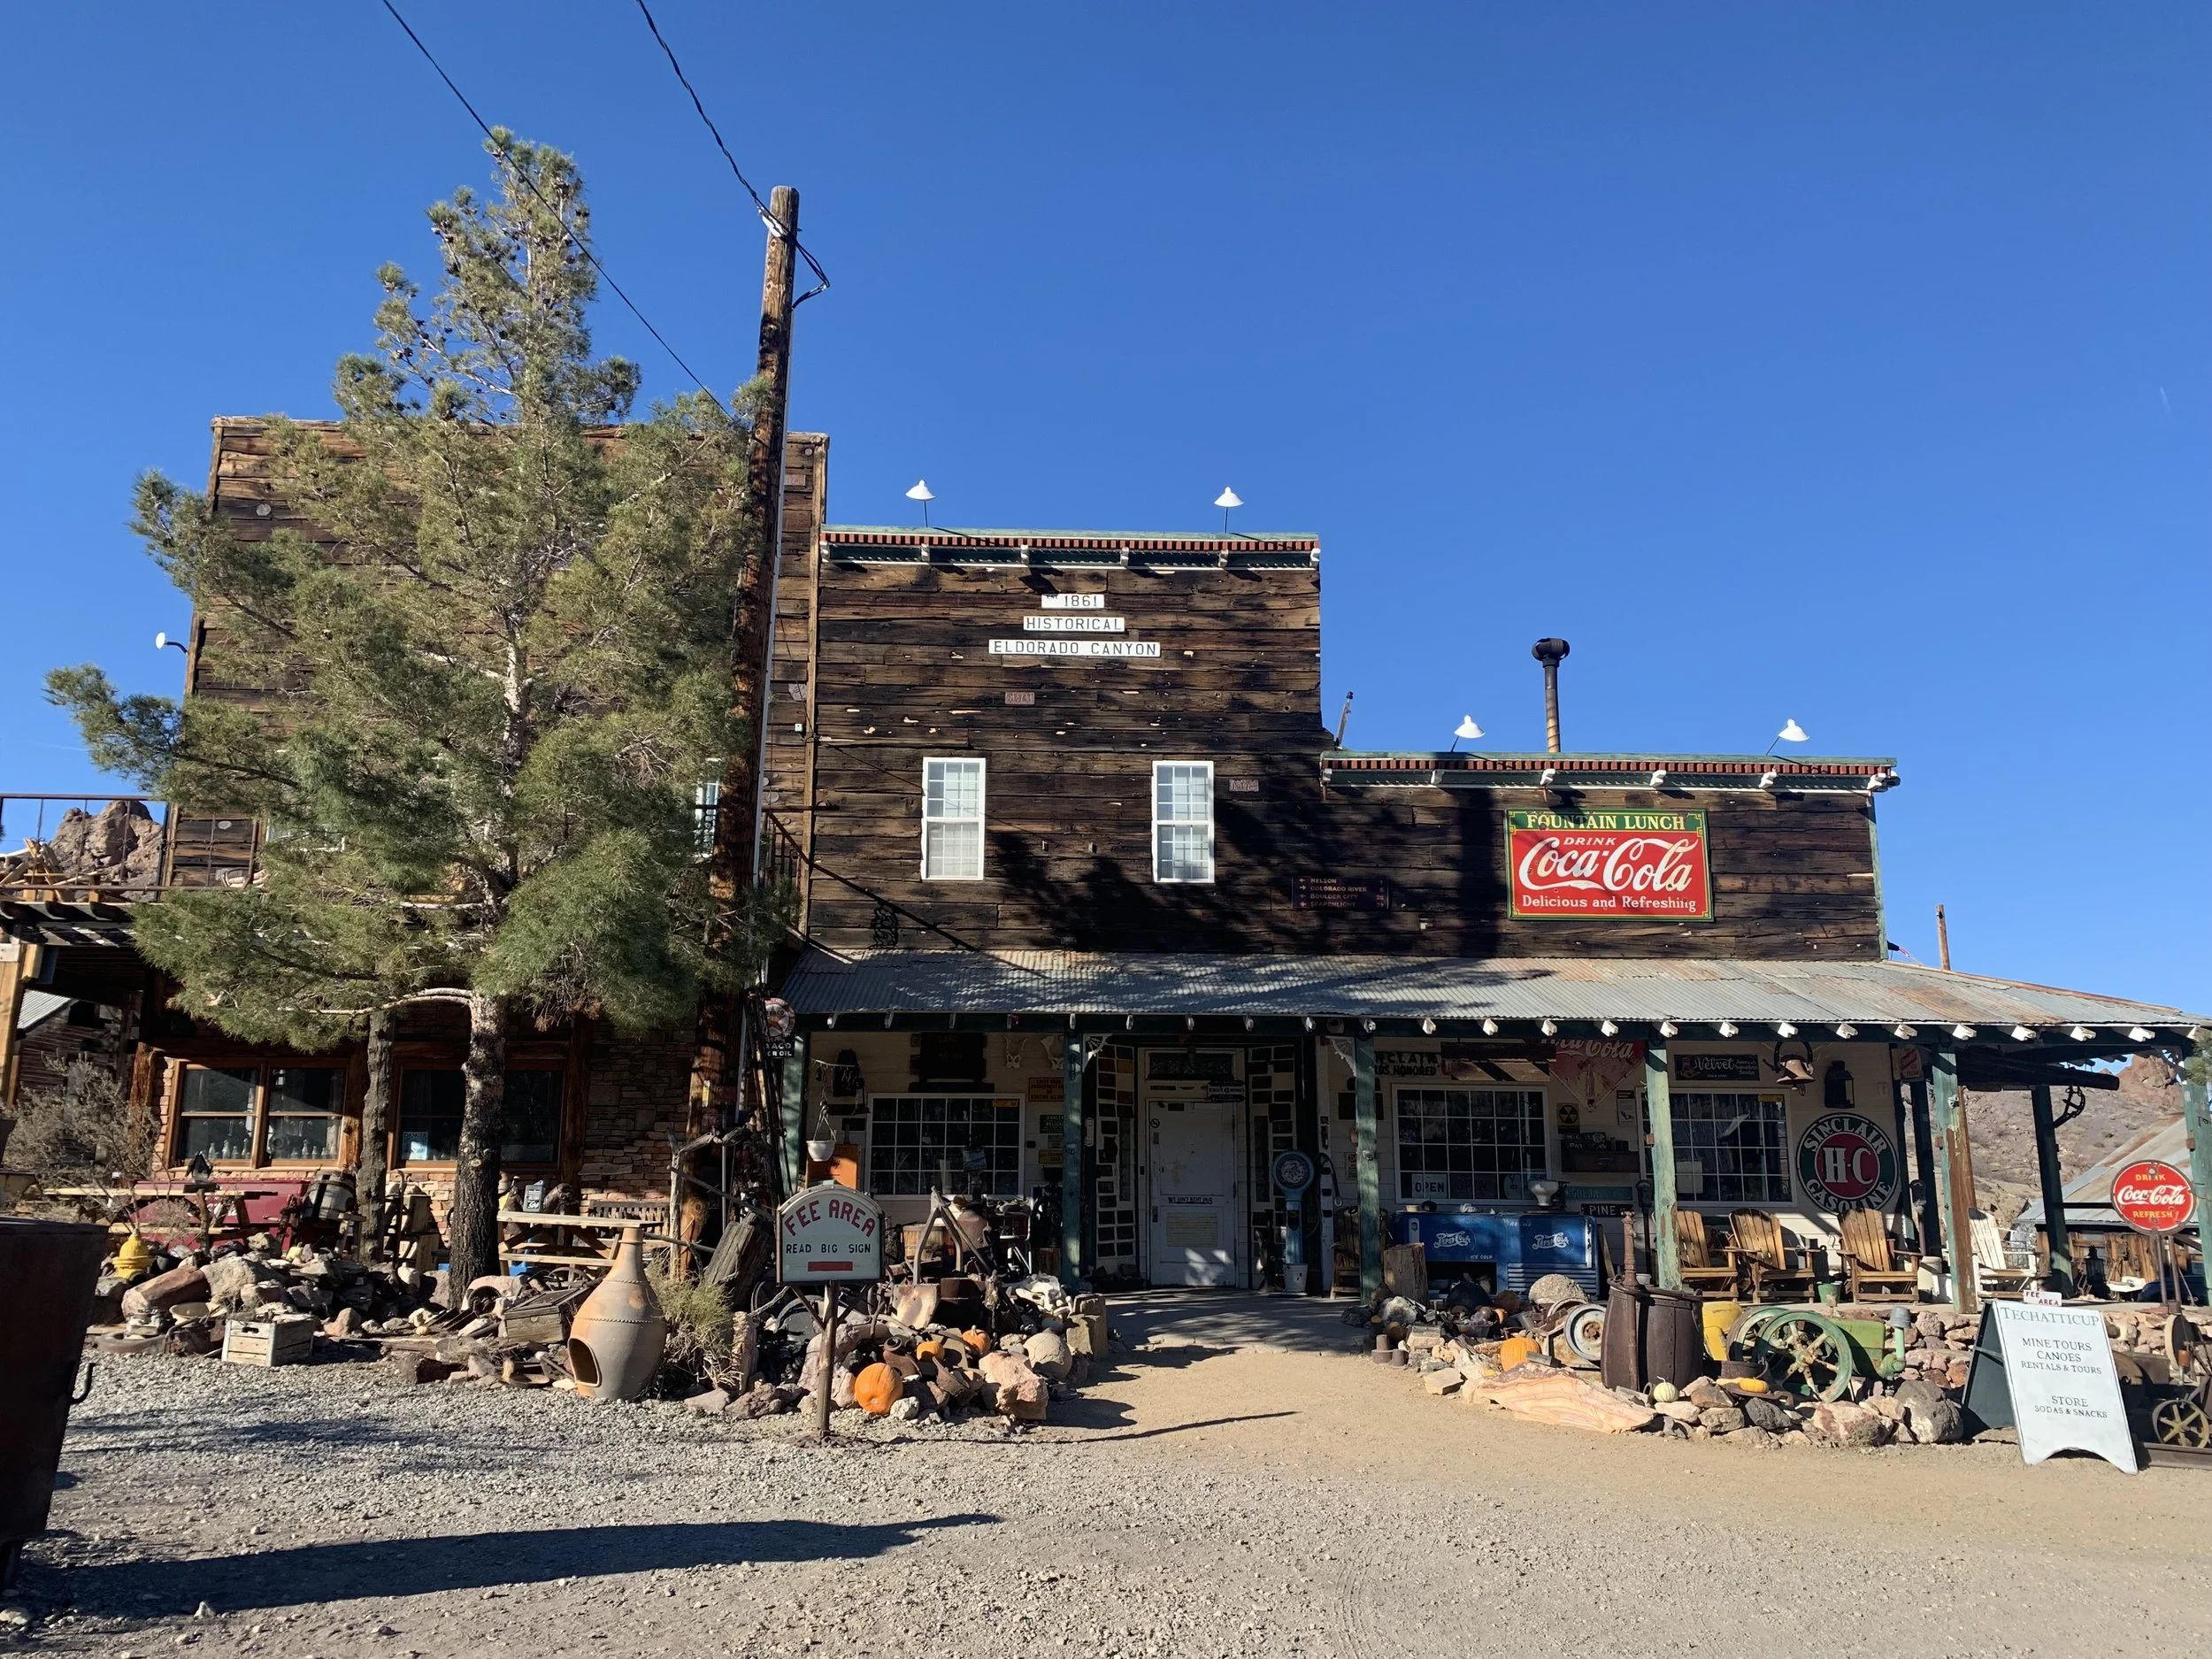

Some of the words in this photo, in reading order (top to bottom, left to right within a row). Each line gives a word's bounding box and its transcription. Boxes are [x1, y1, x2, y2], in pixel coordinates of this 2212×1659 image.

[1064, 595, 1098, 607] 1861
[1025, 618, 1122, 631] HISTORICAL
[994, 641, 1079, 655] ELDORADO
[1091, 642, 1156, 656] CANYON
[1526, 815, 1621, 830] FOUNTAIN
[1624, 816, 1686, 830] LUNCH
[1563, 837, 1617, 846] DRINK
[1518, 836, 1699, 892] Coca-Cola
[1522, 895, 1588, 908] Delicious
[1593, 896, 1616, 908] and
[1622, 895, 1696, 912] Refreshing
[1393, 1064, 1437, 1076] HONORED
[1692, 1056, 1736, 1071] Velvet
[1804, 1118, 1887, 1154] SINCLAIR
[1415, 1181, 1445, 1193] OPEN
[1589, 1205, 1617, 1216] PINE
[784, 1200, 821, 1237] FEE
[828, 1199, 876, 1238] AREA
[786, 1244, 812, 1254] READ
[821, 1243, 838, 1254] BIG
[849, 1243, 872, 1254] SIGN
[2000, 1307, 2100, 1326] TECHATTICUP
[2022, 1337, 2052, 1348] MINE
[2053, 1340, 2092, 1351] TOURS
[2037, 1350, 2082, 1363] CANOES
[2021, 1361, 2062, 1371] RENTALS
[2070, 1365, 2102, 1375] TOURS
[2051, 1395, 2089, 1407] STORE
[2034, 1405, 2063, 1415] SODAS
[2073, 1409, 2108, 1418] SNACKS
